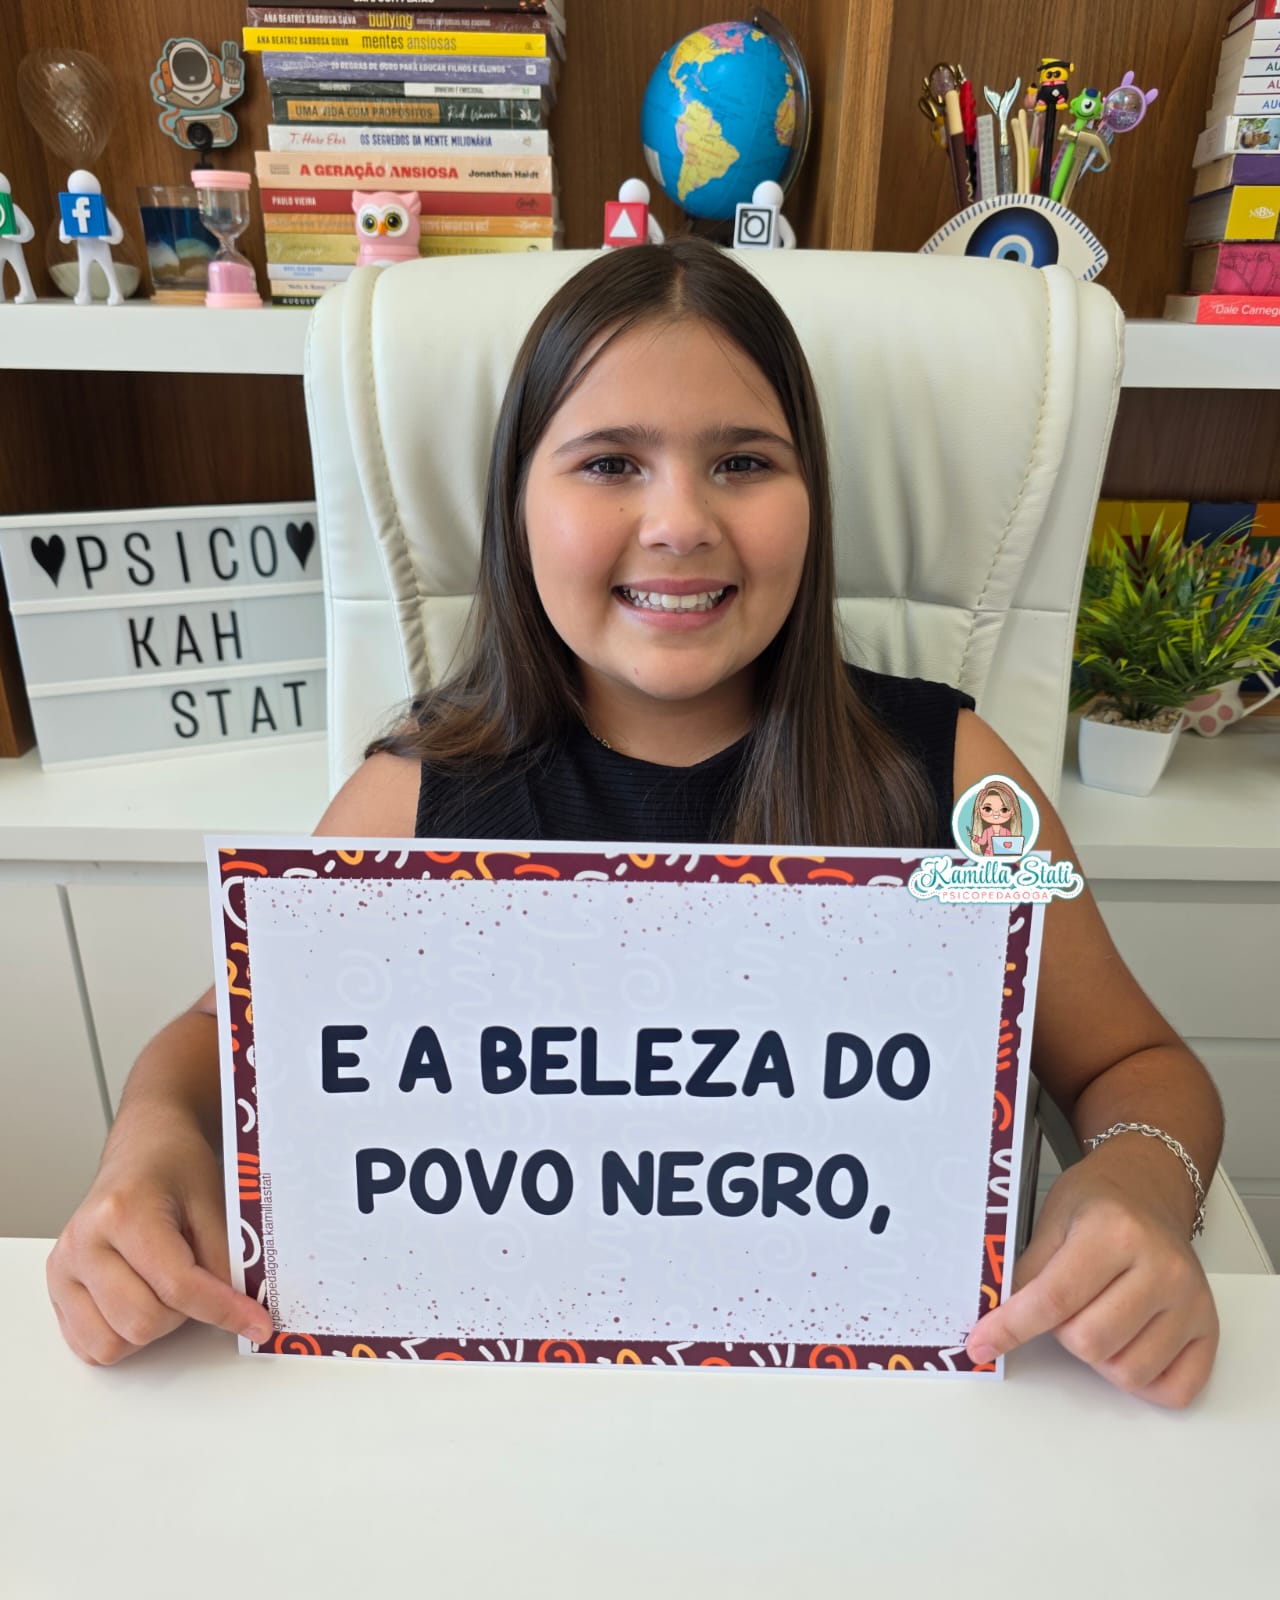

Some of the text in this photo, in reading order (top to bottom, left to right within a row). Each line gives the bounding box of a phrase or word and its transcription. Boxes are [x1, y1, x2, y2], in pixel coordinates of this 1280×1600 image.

[263, 13, 277, 24] ANA
[279, 14, 305, 24] BEATRIZ
[307, 14, 337, 25] BARBOSA
[338, 15, 357, 25] SILVA
[368, 11, 414, 30] bullying
[257, 34, 456, 51] ANA BEATRIZ BARBOSA SILVA mentes ansiosas
[341, 62, 367, 70] REGRAS
[368, 62, 378, 70] DE
[419, 63, 446, 72] EDUCAR
[295, 105, 318, 115] UMA
[322, 106, 345, 116] VIDA
[347, 106, 369, 116] COM
[360, 133, 493, 147] OS SEGREDOS DA MENTE MILIONÁRIA
[300, 164, 311, 176] A
[314, 162, 386, 180] GERAÇÃO
[390, 165, 459, 179] ANSIOSA
[468, 169, 539, 179] Jonathan Haidt
[272, 195, 316, 206] PAULO VIEIRA
[282, 297, 317, 305] AUGUST
[1216, 304, 1239, 314] Dale
[76, 525, 278, 590] PSICO
[128, 611, 243, 669] KAH
[171, 681, 307, 738] STAT
[322, 1025, 930, 1101] E A BELEZA DO
[355, 1148, 891, 1235] POVO NEGRO,
